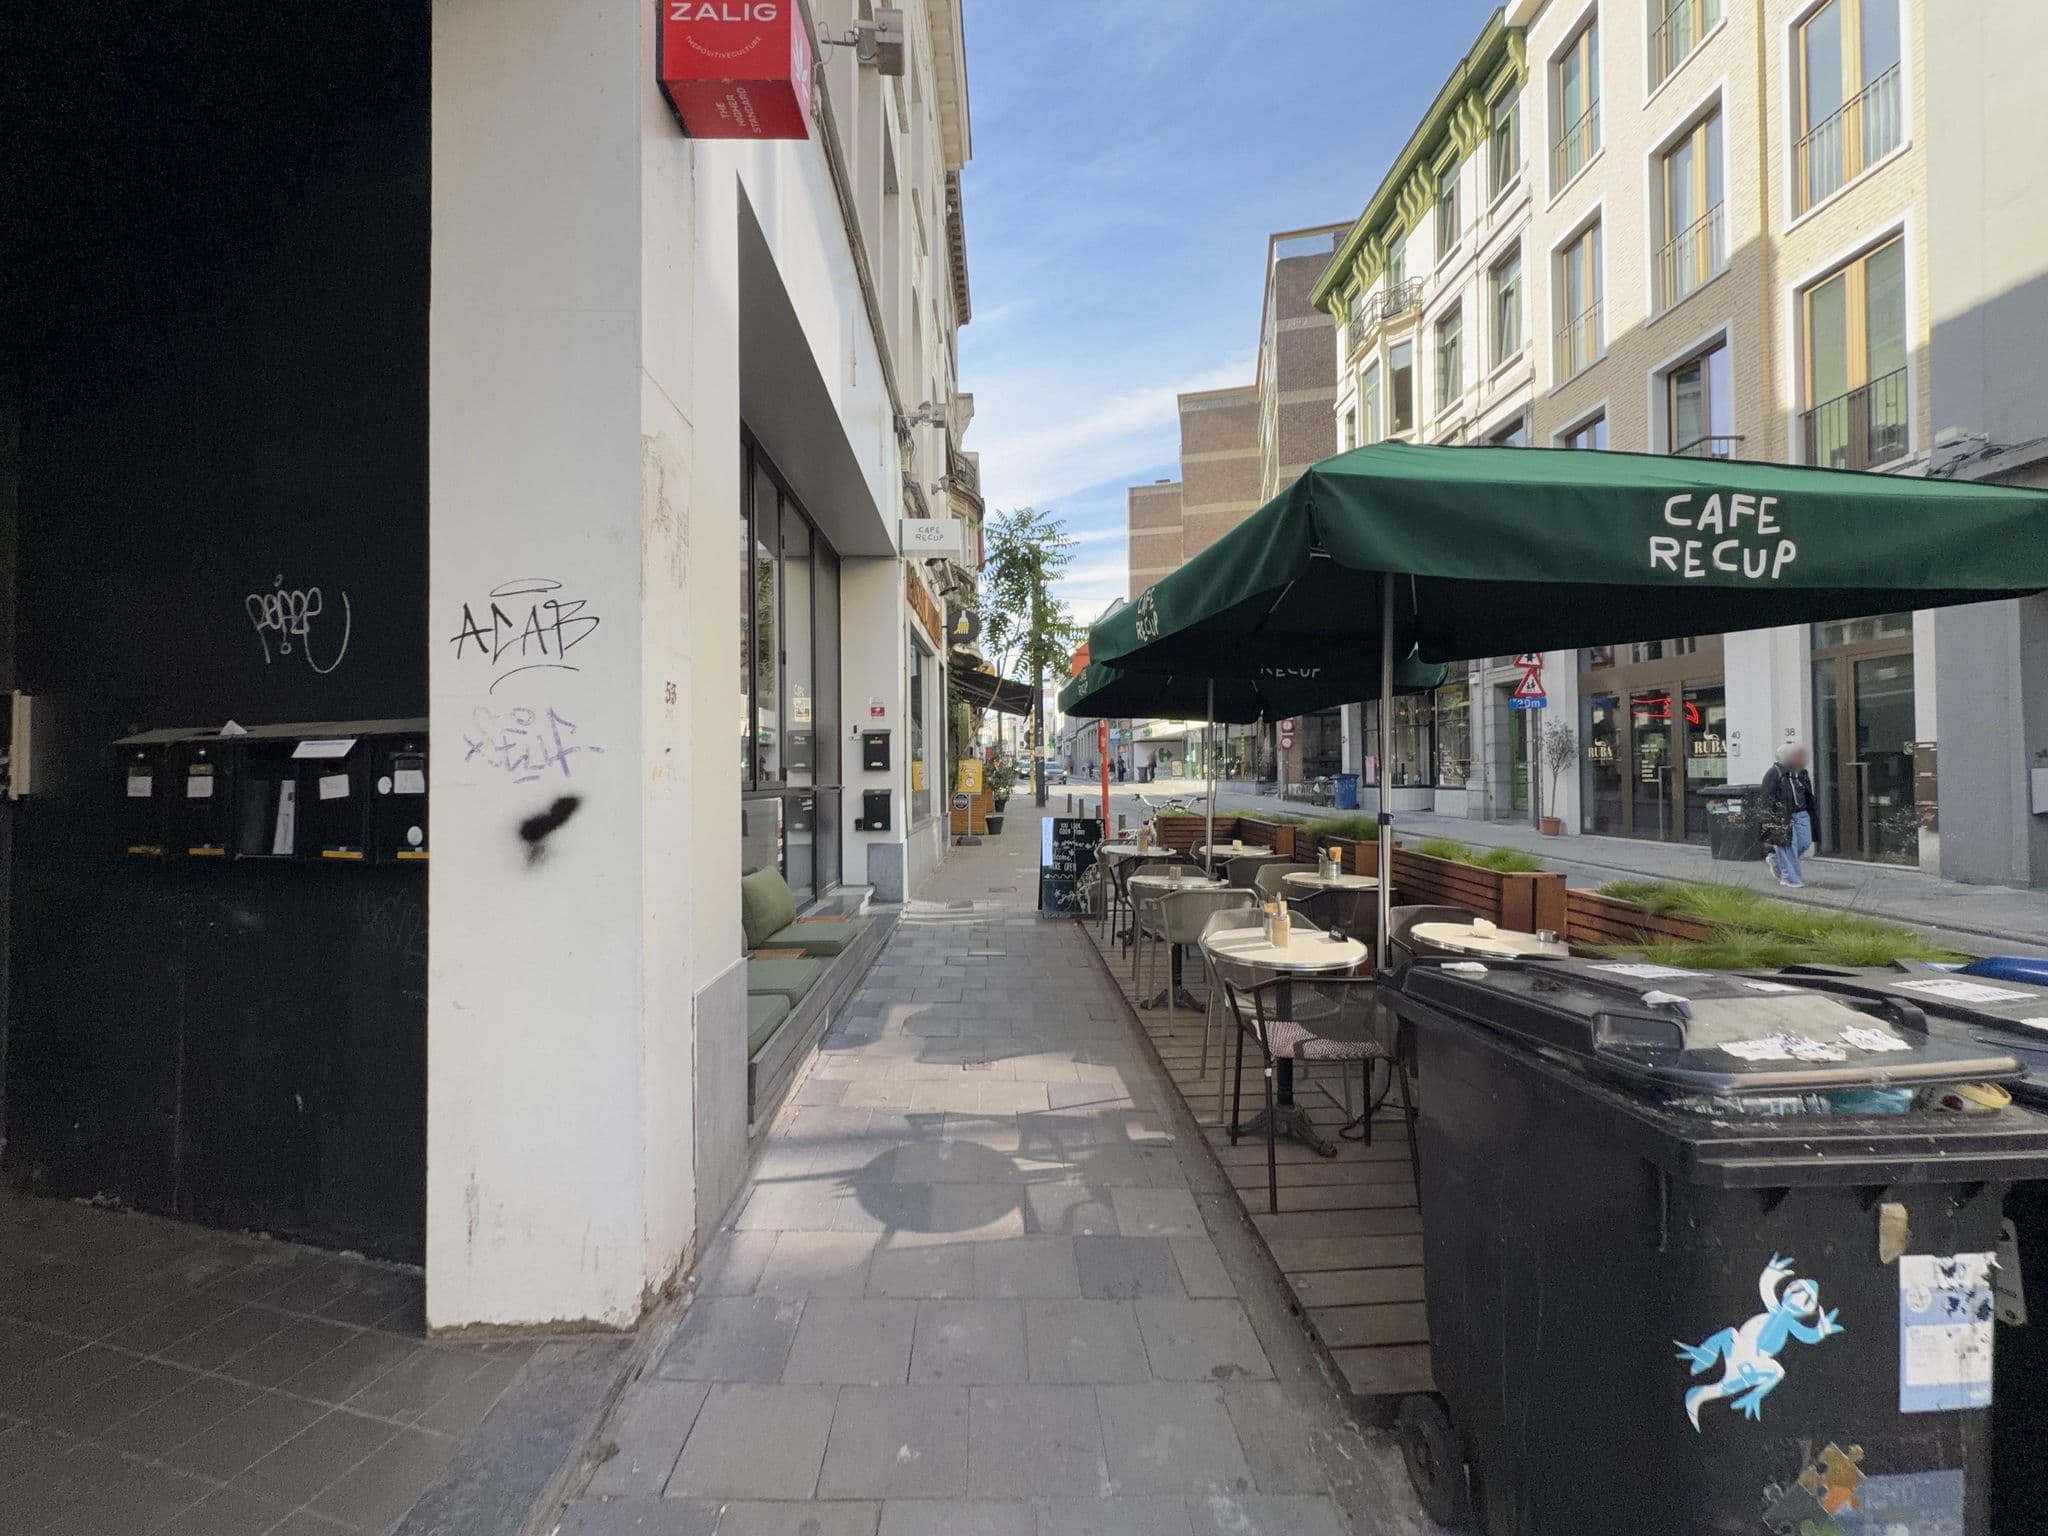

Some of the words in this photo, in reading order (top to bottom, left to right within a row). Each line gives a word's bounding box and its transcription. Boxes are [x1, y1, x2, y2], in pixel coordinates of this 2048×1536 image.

[670, 2, 778, 22] ZALIG
[715, 101, 730, 119] THE
[1664, 492, 1782, 535] CAFE
[915, 533, 944, 542] RECUP
[918, 526, 941, 534] CAFE
[1648, 535, 1797, 580] RECUP
[1137, 587, 1155, 616] CAFE
[449, 599, 601, 665] ACAB
[1135, 611, 1159, 642] RECUP
[1731, 731, 1741, 740] 40
[1784, 728, 1796, 737] 38
[1587, 746, 1613, 758] RUBA
[1693, 740, 1727, 754] RUBA
